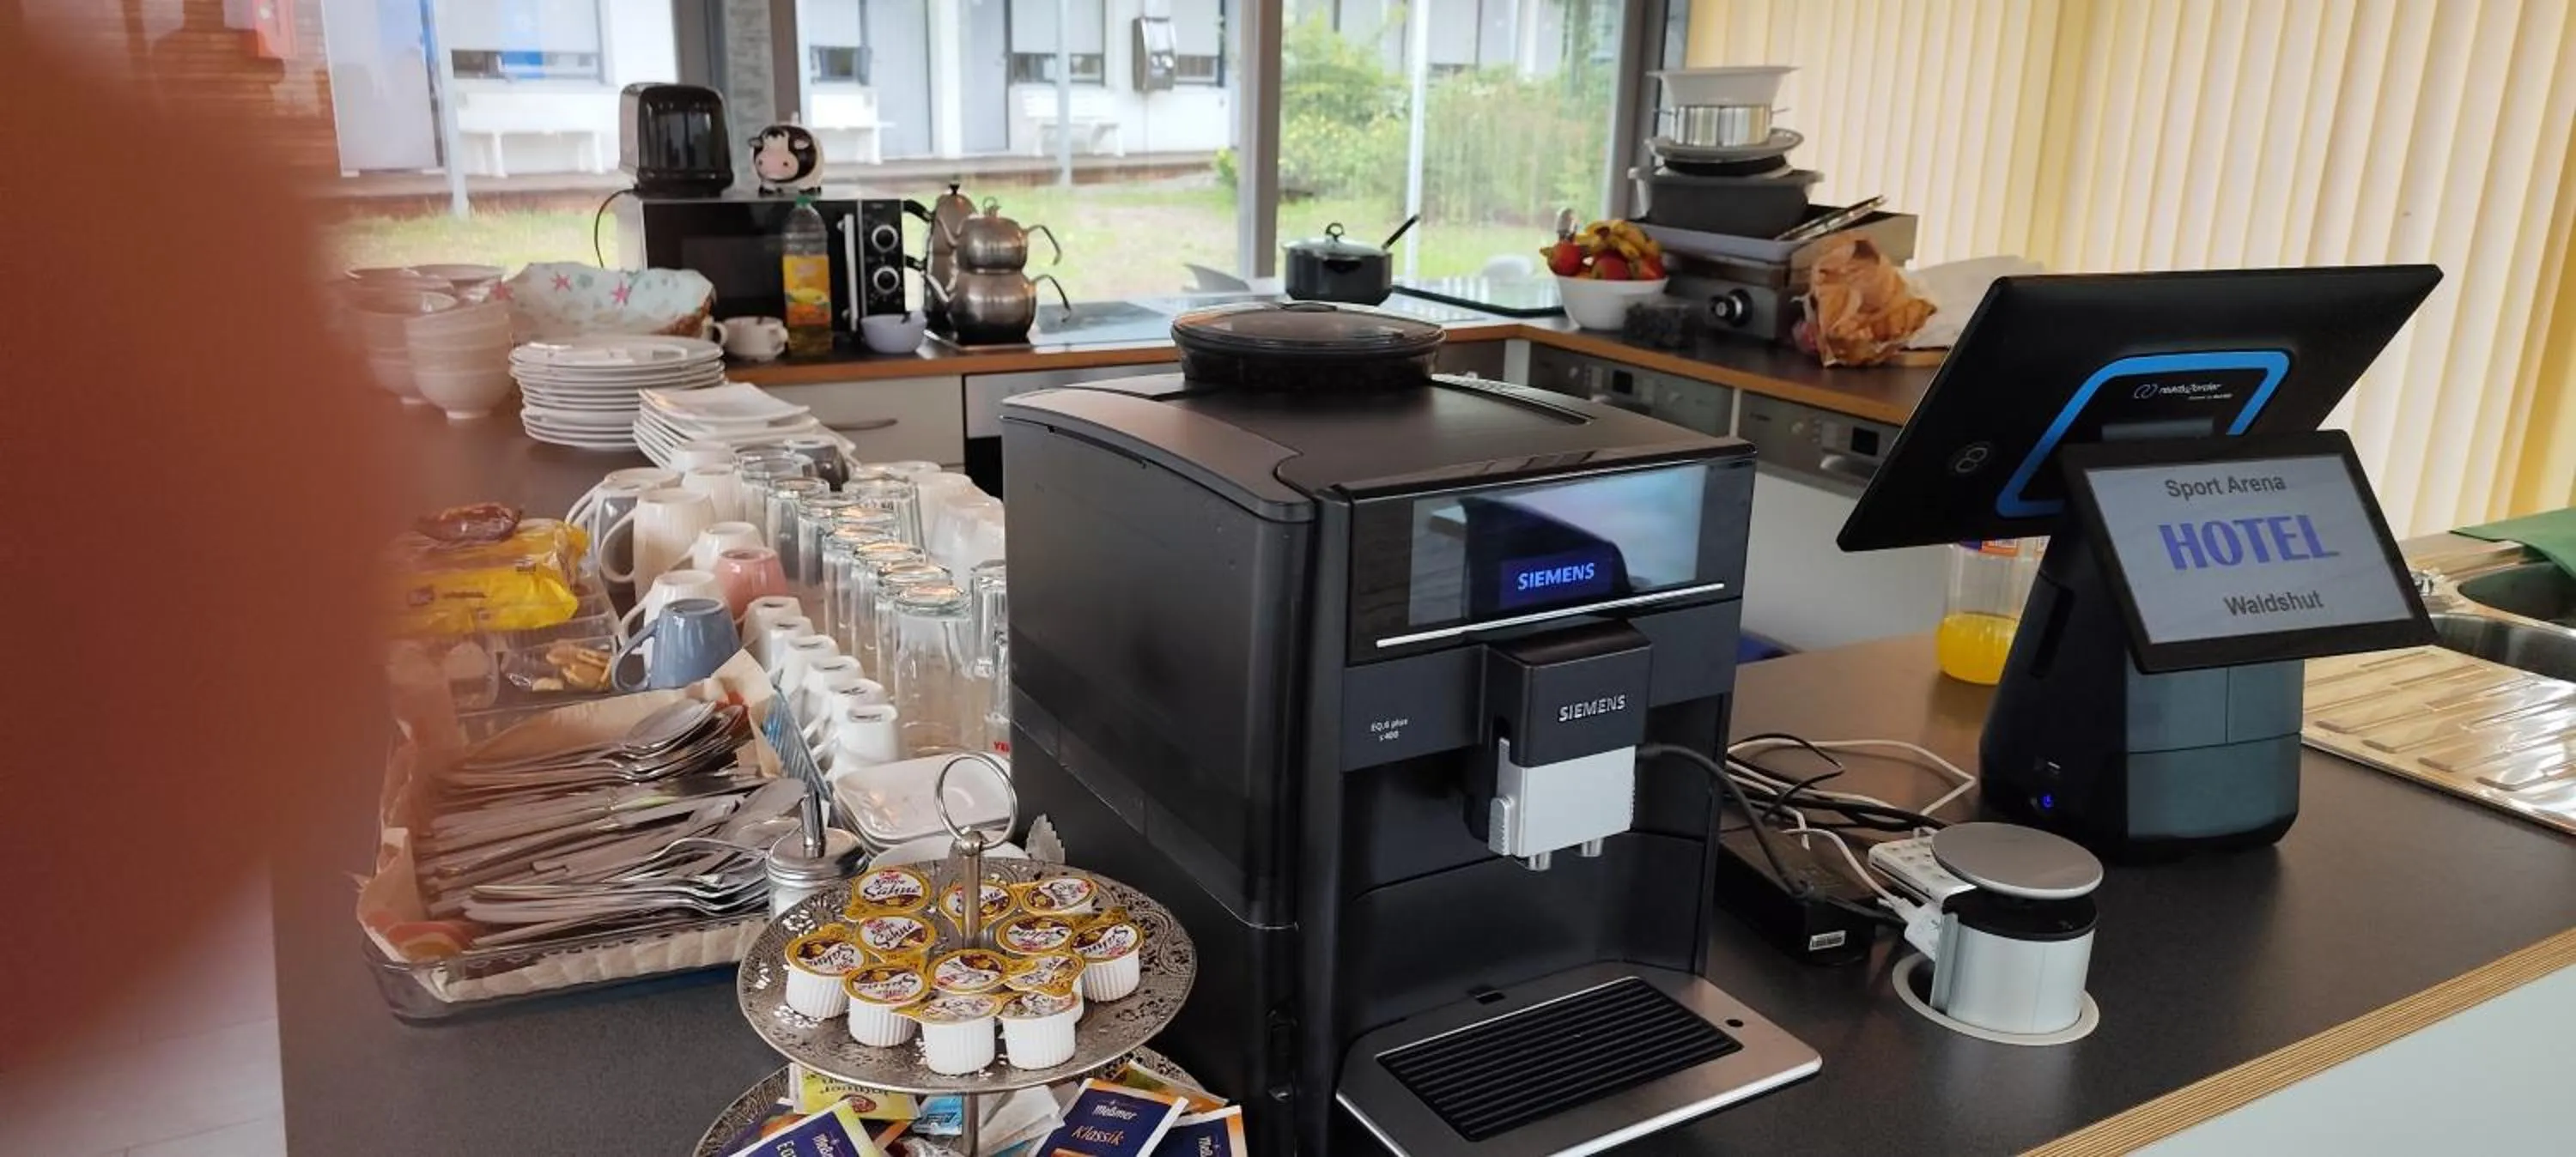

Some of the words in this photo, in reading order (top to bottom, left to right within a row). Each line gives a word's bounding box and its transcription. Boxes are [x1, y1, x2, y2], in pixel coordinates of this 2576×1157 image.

[2164, 477, 2223, 501] Sport
[2227, 475, 2287, 494] Arena
[2158, 515, 2341, 571] HOTEL
[1517, 562, 1595, 591] SIEMENS
[2222, 590, 2324, 616] Waldshut
[1558, 694, 1625, 722] SIEMENS
[1072, 1125, 1124, 1146] Klassik
